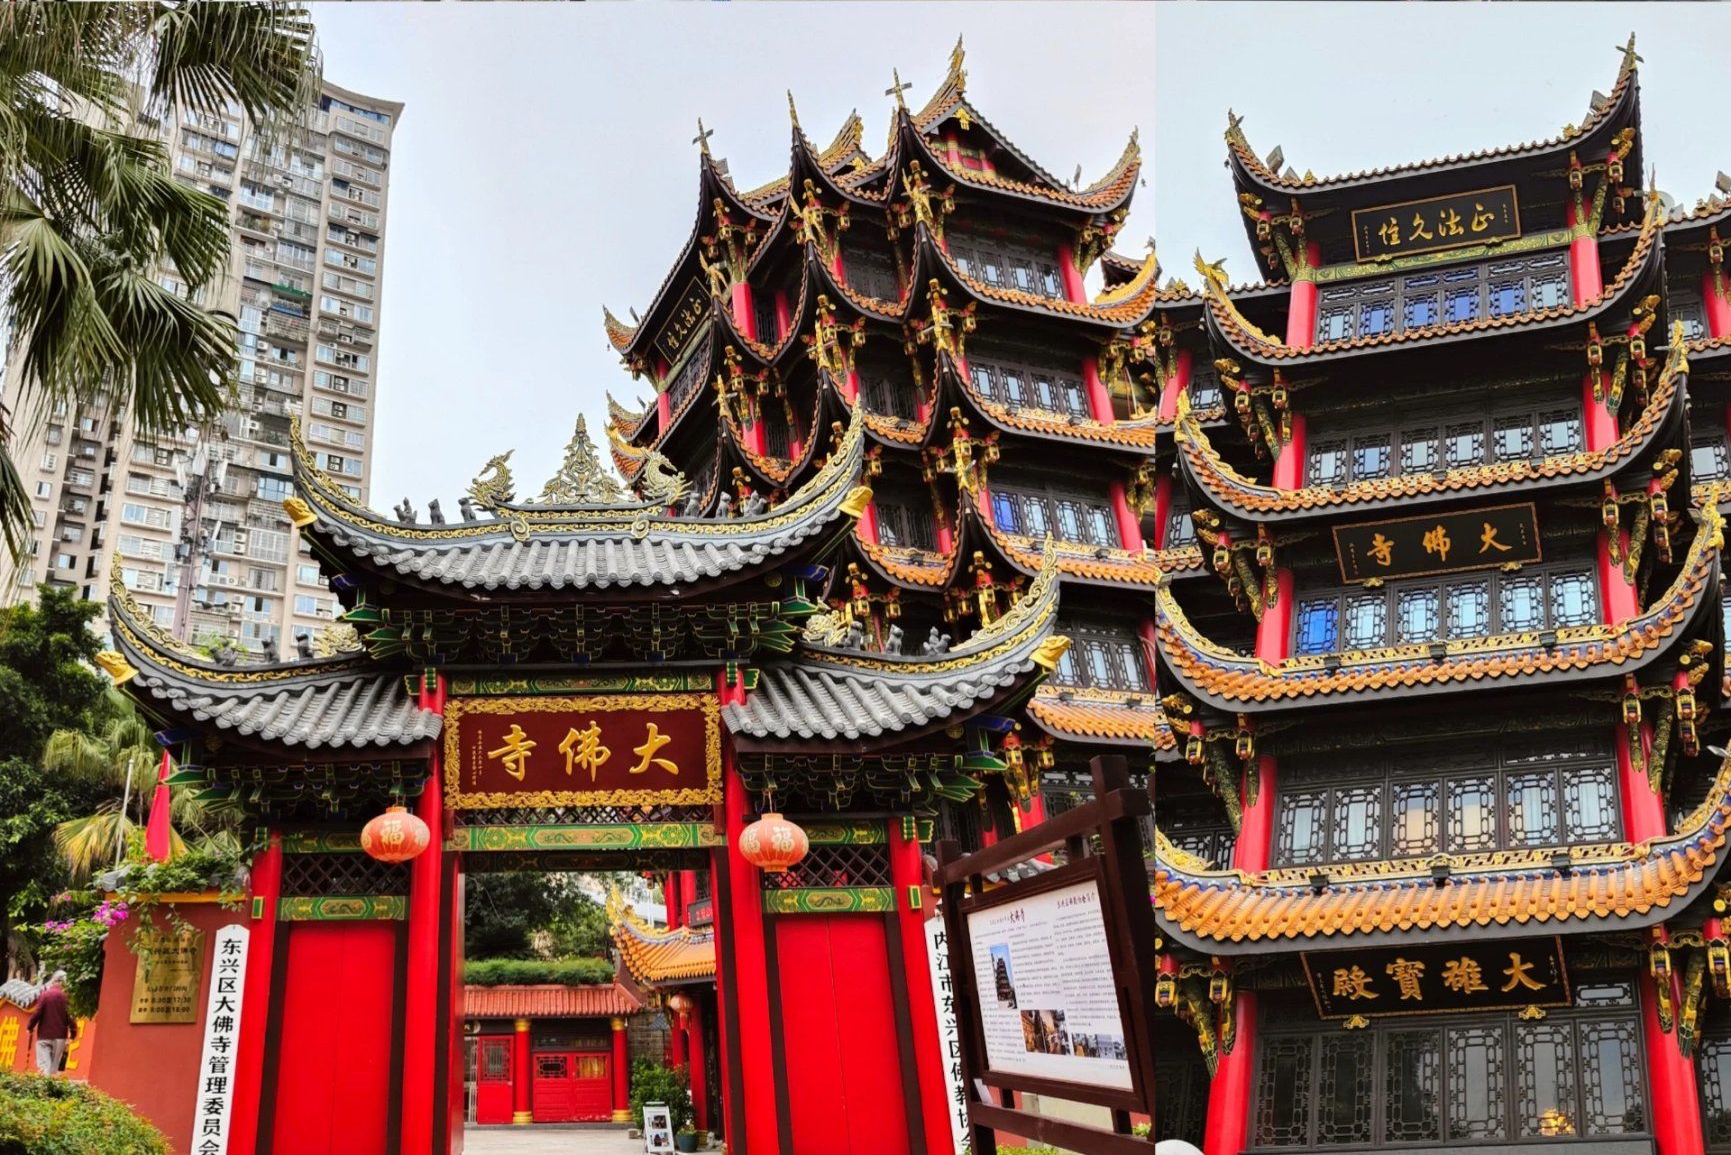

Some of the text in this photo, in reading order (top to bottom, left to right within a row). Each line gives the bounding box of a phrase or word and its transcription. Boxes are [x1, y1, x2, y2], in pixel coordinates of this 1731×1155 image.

[1366, 522, 1512, 567] 大佛寺
[487, 720, 679, 782] 大佛寺
[380, 819, 405, 846] 福
[771, 826, 796, 852] 福
[198, 939, 242, 1155] 东兴区大佛寺管理委员会
